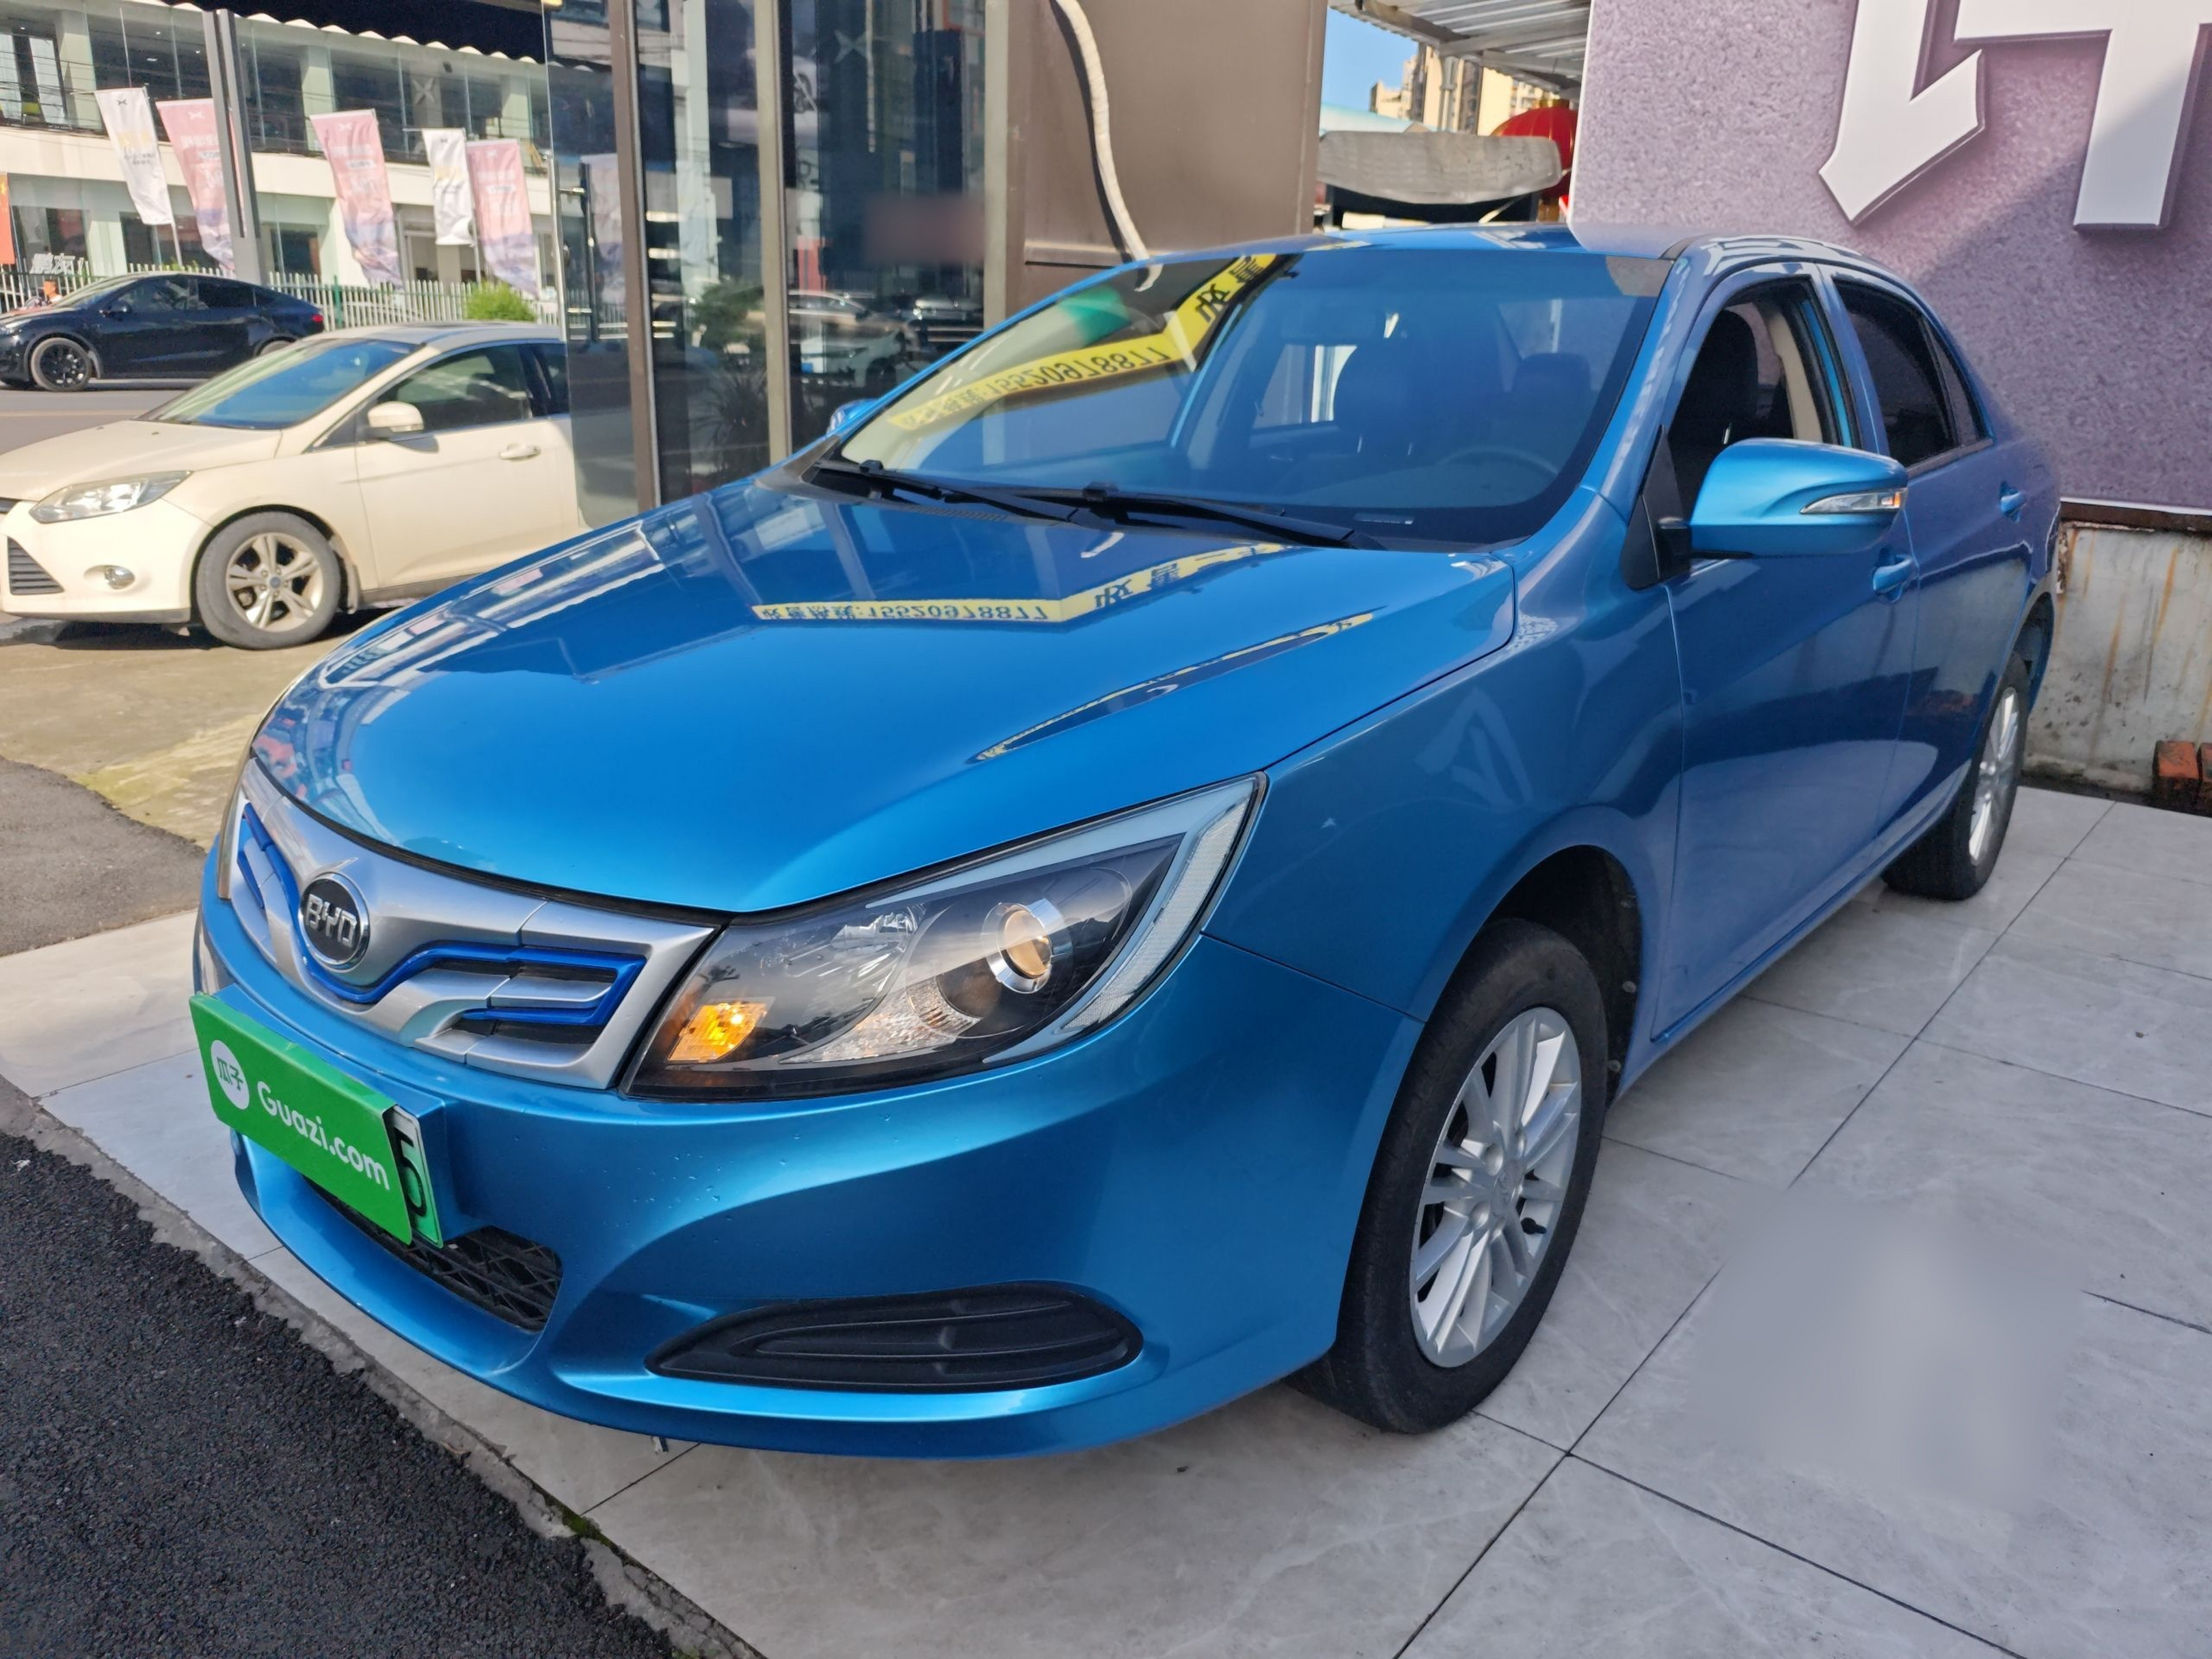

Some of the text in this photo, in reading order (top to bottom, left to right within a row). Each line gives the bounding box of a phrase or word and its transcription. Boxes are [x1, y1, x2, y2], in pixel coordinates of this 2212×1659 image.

[305, 893, 358, 948] BYD
[217, 1057, 244, 1090] 瓜子
[257, 1081, 390, 1191] Guazi.com
